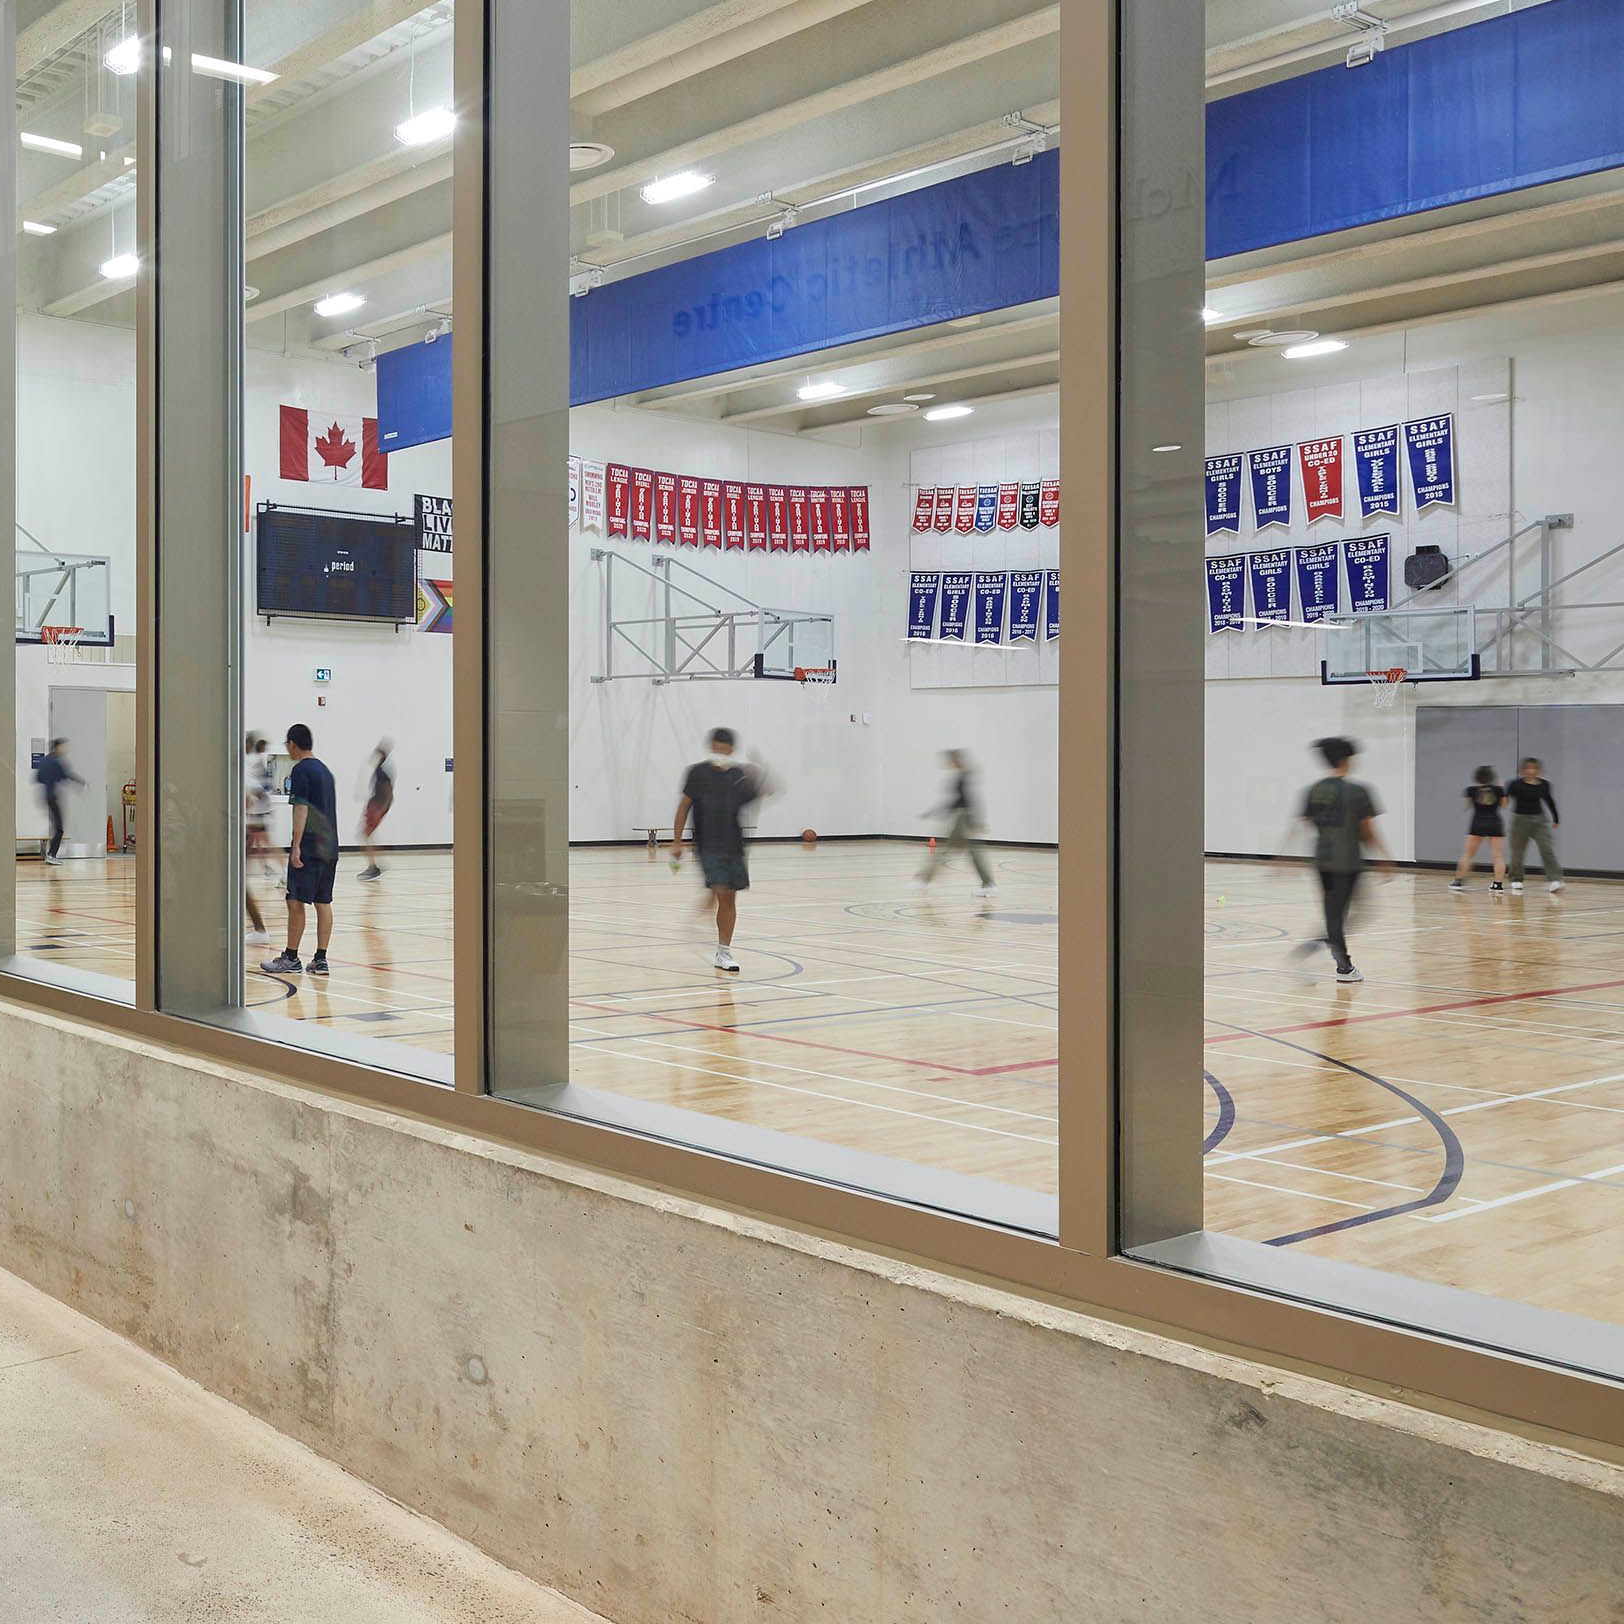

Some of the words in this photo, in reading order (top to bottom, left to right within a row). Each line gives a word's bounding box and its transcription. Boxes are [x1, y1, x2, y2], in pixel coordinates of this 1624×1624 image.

[1410, 420, 1446, 434] SSAF
[1359, 431, 1393, 444] SSAF
[1409, 429, 1448, 442] ELEMENTARY
[1304, 441, 1336, 454] SSAF
[1358, 440, 1395, 452] ELEMENTARY
[1416, 438, 1443, 448] GIRLS
[1255, 450, 1286, 462] SSAF
[1305, 452, 1328, 461] UNDER
[1364, 448, 1390, 458] GIRLS
[1208, 458, 1238, 470] SSAF
[1254, 459, 1288, 469] ELEMENTARY
[1308, 457, 1335, 467] CO-ED
[1206, 466, 1239, 476] ELEMENTARY
[1211, 474, 1233, 482] GIRLS
[1267, 475, 1277, 506] SOCCER
[1418, 483, 1449, 493] CHAMPIONS
[1218, 482, 1226, 512] SOCCER
[1364, 493, 1394, 502] CHAMPIONS
[1425, 491, 1443, 499] 2015
[422, 497, 453, 515] BLA
[1310, 497, 1339, 507] CHAMPIONS
[1370, 501, 1389, 509] 2015
[1259, 505, 1287, 514] CHAMPIONS
[424, 515, 453, 533] LIV
[423, 533, 453, 552] MATT
[1349, 539, 1384, 551] SSAF
[1301, 546, 1334, 558] SSAF
[1348, 547, 1385, 558] ELEMENTARY
[1255, 553, 1286, 563] SSAF
[1299, 555, 1335, 564] ELEMENTARY
[1354, 556, 1380, 564] CO-ED
[331, 561, 355, 572] period
[1211, 559, 1241, 568] SSAF
[1253, 561, 1288, 569] ELEMENTARY
[1306, 562, 1329, 570] GIRLS
[1267, 577, 1276, 608] SOCCER
[1355, 598, 1384, 606] CHAMPIONS
[1305, 604, 1334, 612] CHAMPIONS
